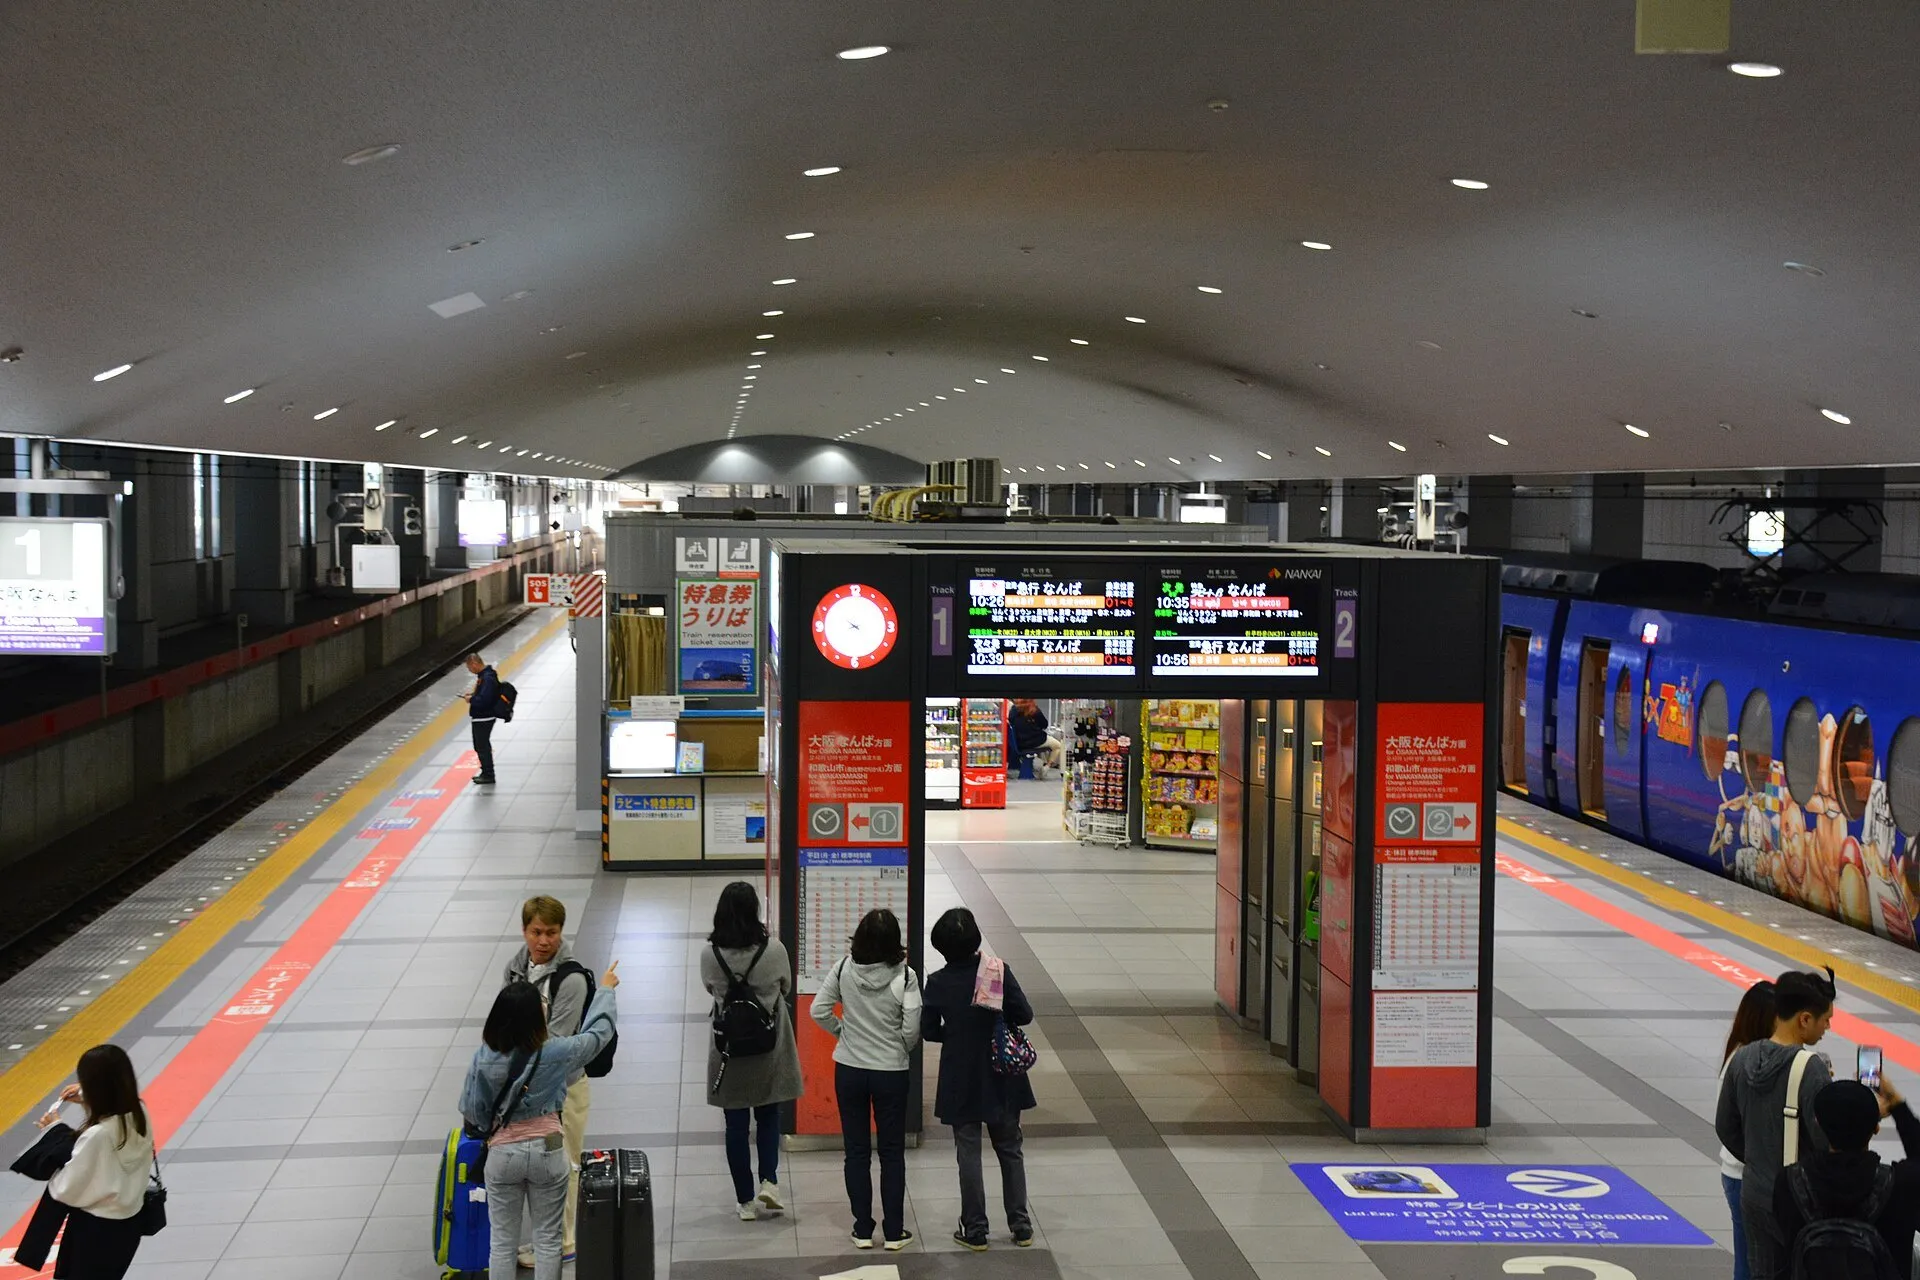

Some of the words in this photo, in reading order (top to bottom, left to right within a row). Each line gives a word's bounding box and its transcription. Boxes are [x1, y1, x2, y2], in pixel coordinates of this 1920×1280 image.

[14, 529, 41, 575] 1
[1285, 569, 1322, 579] NANKAI
[683, 584, 752, 604] 特急券
[849, 584, 861, 597] 12
[931, 586, 955, 594] Track
[1043, 582, 1082, 596] なんば
[1228, 583, 1266, 597] なんば
[1335, 589, 1358, 597] Track
[971, 595, 1005, 607] 10:26
[1157, 597, 1189, 608] 10:35
[682, 607, 752, 627] うりば
[815, 620, 824, 633] 9
[887, 620, 895, 633] 3
[932, 608, 948, 645] 1
[1337, 611, 1353, 648] 2
[1042, 639, 1081, 653] なんば
[1227, 640, 1265, 654] なんば
[850, 656, 860, 669] 6
[971, 653, 1003, 664] 10:39
[1156, 654, 1188, 666] 10:56
[1446, 1201, 1585, 1211] ラピートのりば
[1481, 1211, 1578, 1220] boarding
[1583, 1211, 1669, 1221] location
